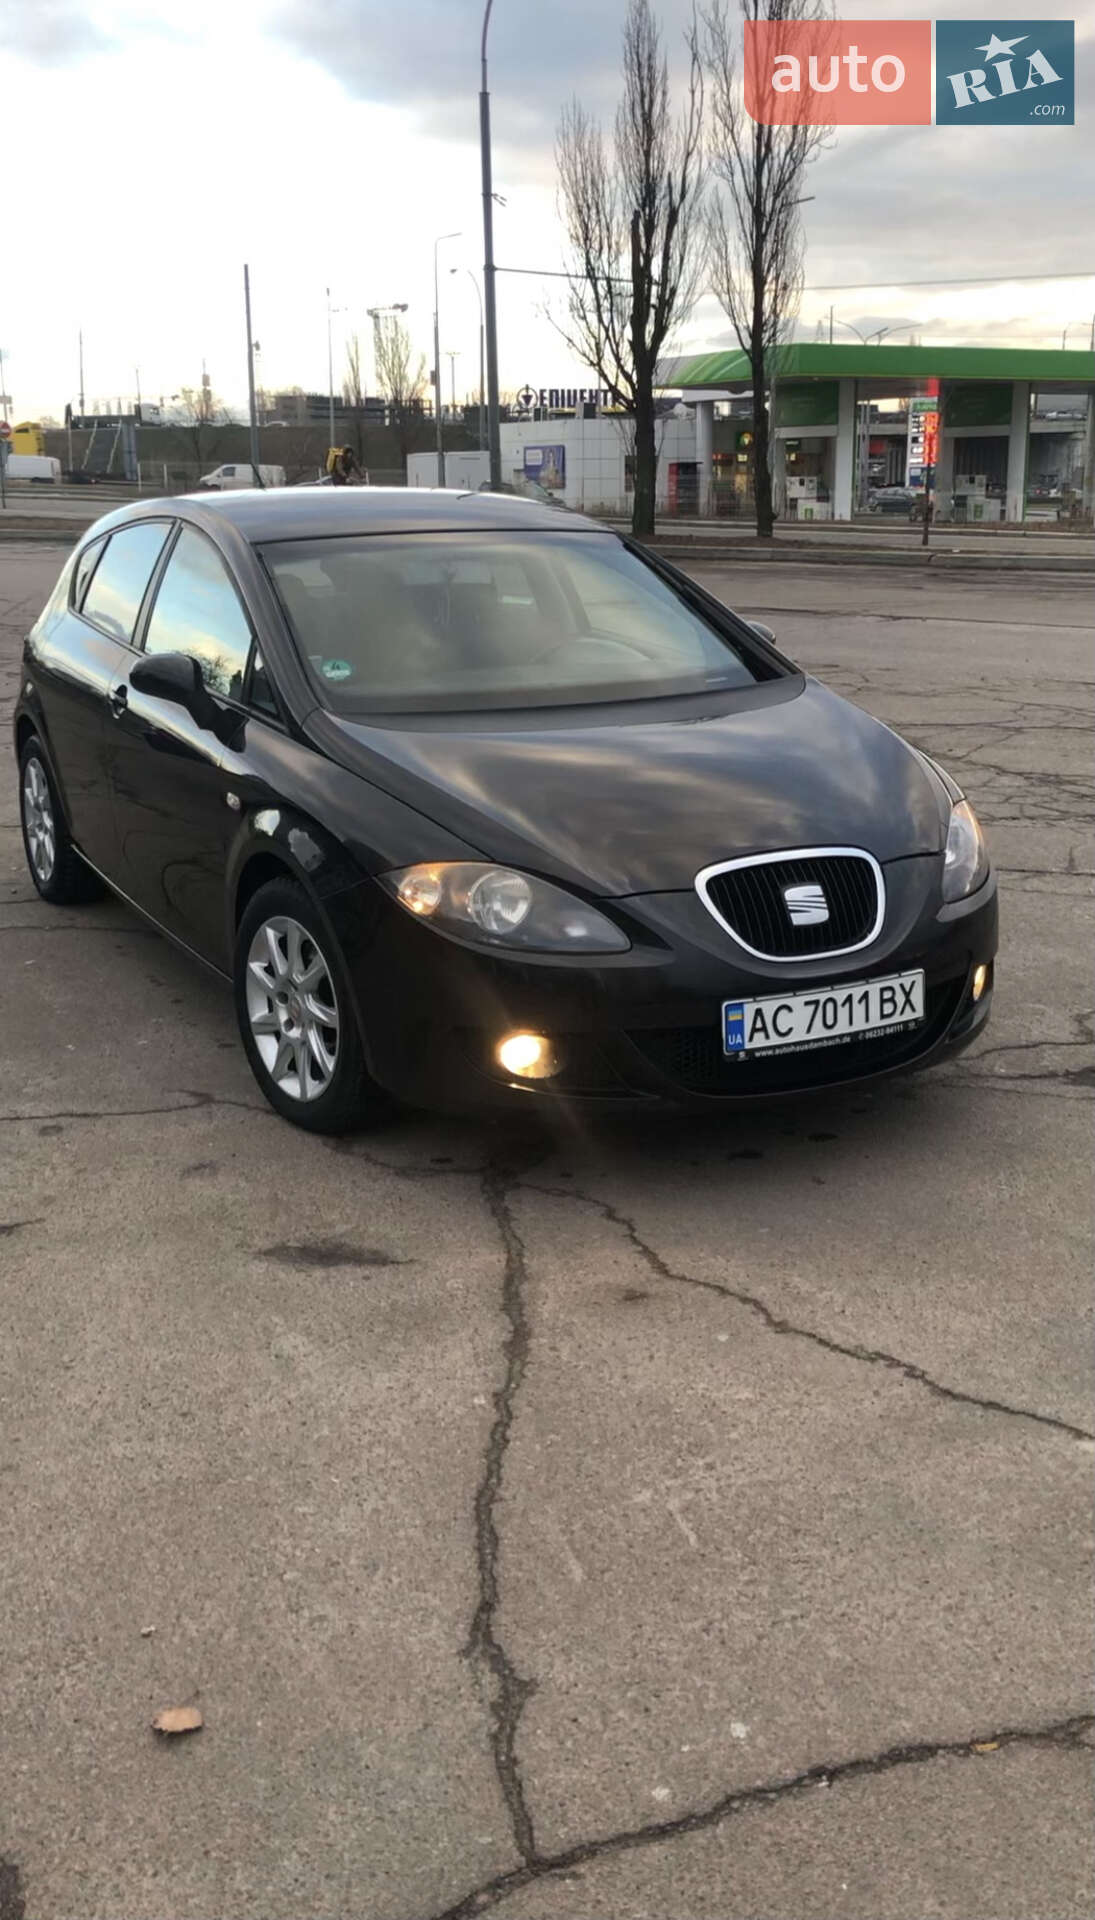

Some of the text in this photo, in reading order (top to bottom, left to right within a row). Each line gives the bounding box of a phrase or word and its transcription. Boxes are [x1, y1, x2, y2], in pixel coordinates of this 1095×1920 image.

[748, 980, 916, 1043] AC 7011 BX
[728, 1034, 743, 1046] UA
